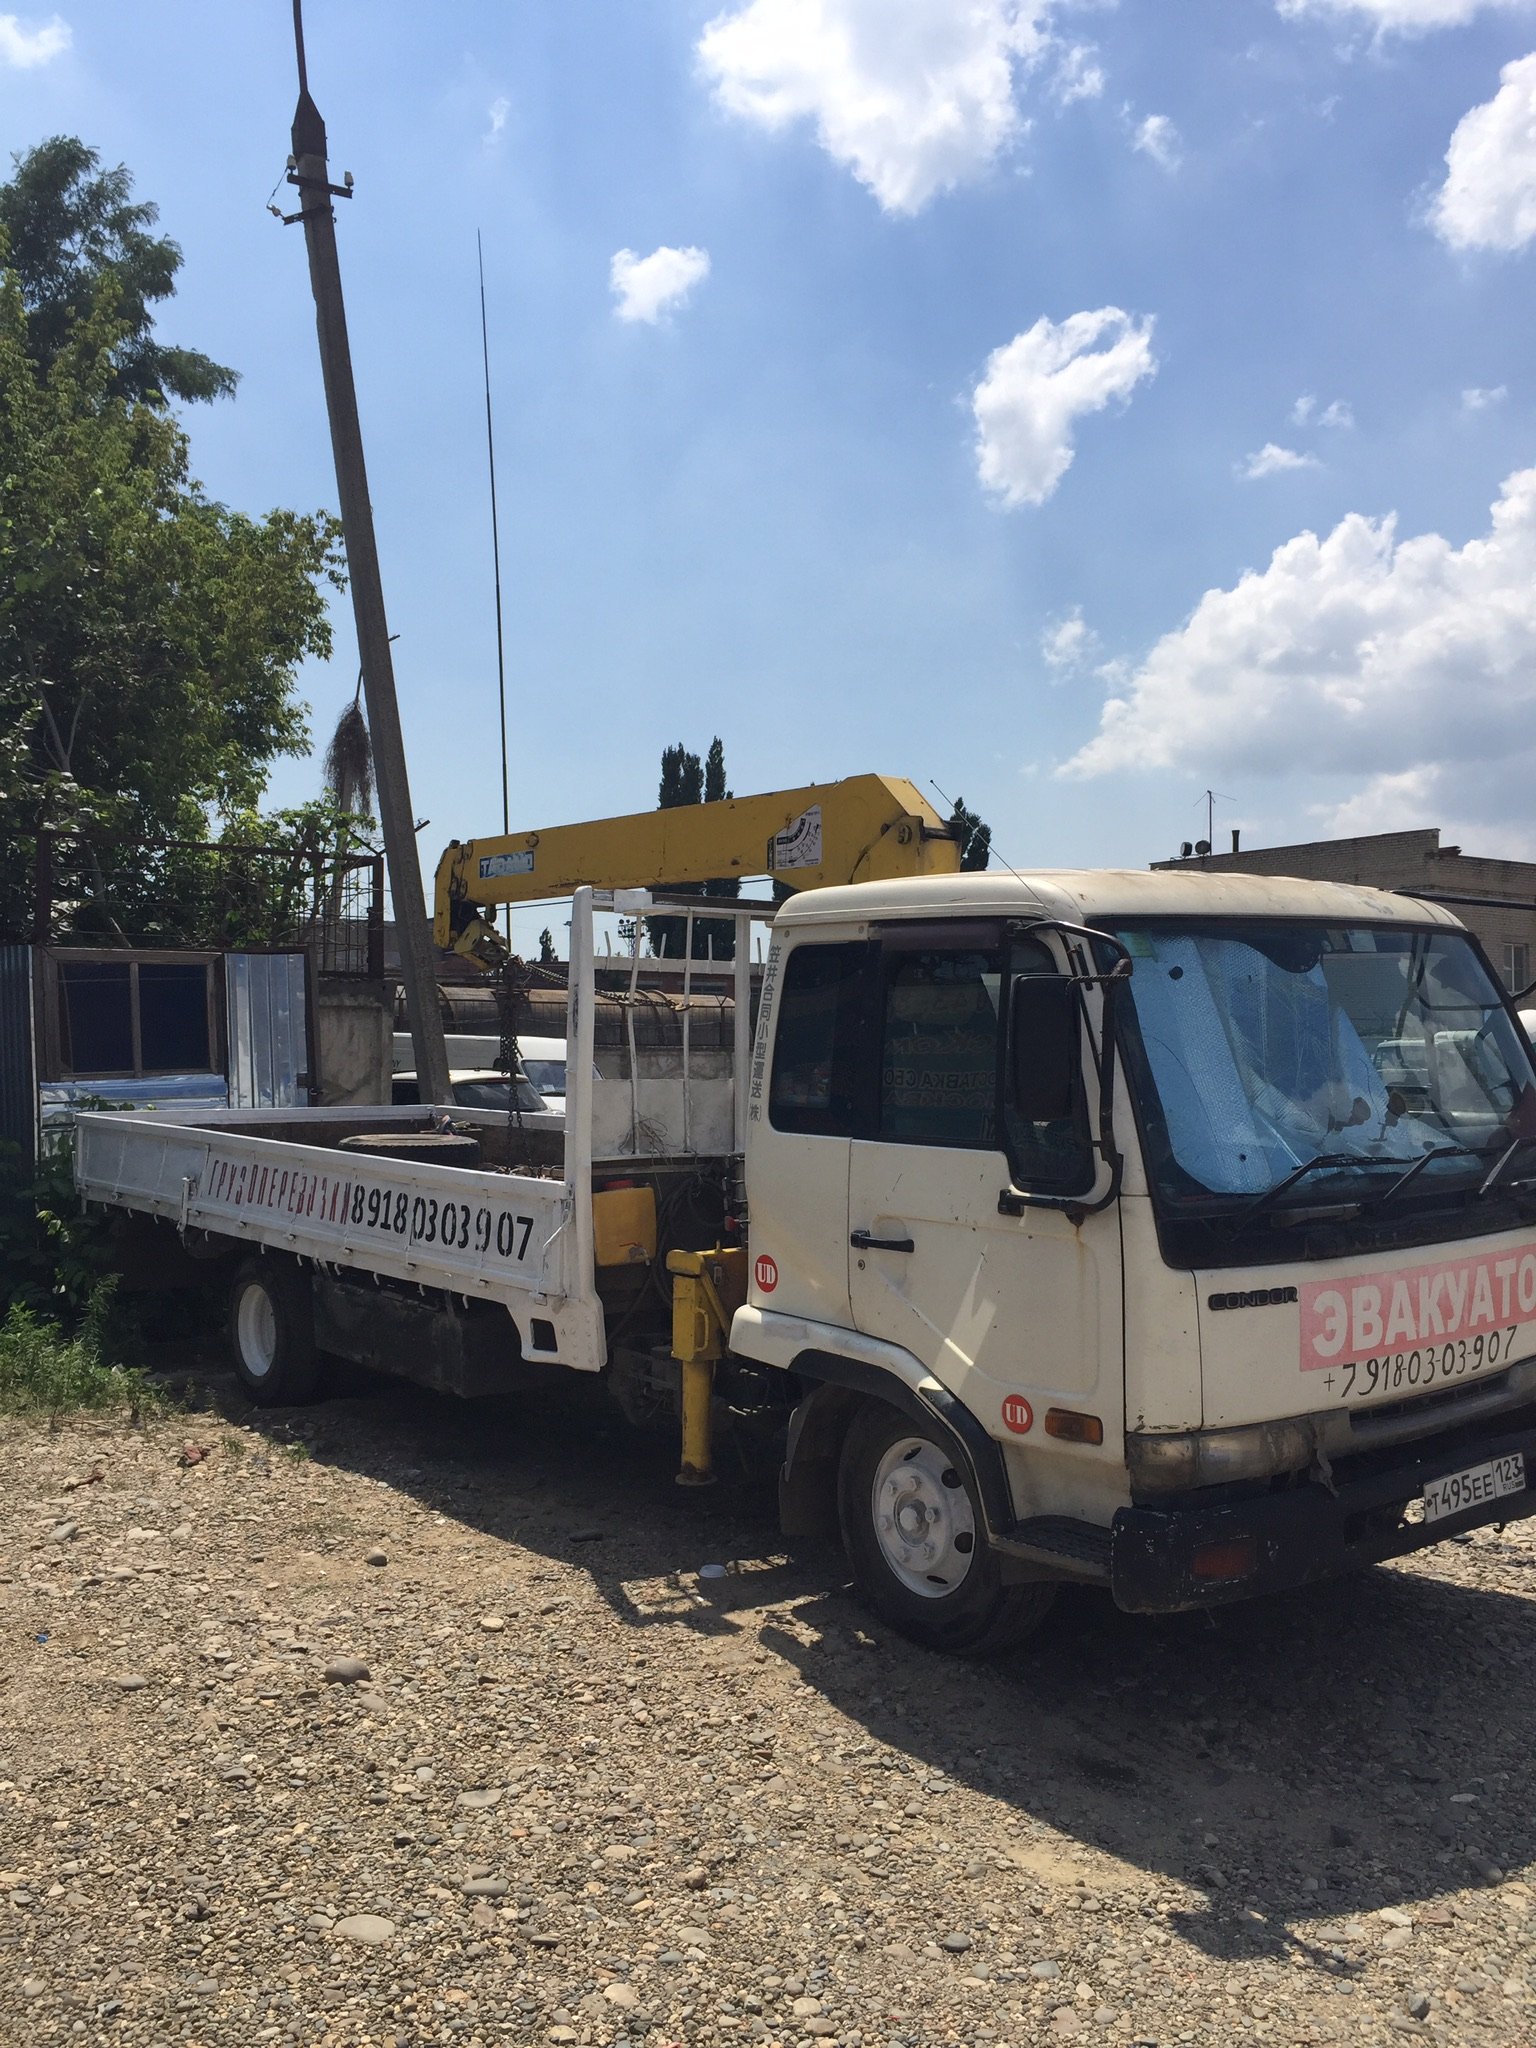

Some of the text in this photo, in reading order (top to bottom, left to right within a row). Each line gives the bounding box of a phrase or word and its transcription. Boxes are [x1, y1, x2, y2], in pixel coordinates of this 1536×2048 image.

[208, 1160, 534, 1261] ГРУЗОПЕРЕВОЗКИ 89180303907
[1208, 1286, 1298, 1311] CONDOR
[1005, 1403, 1028, 1425] UD
[1496, 1457, 1522, 1483] 123
[1503, 1481, 1516, 1491] RUS
